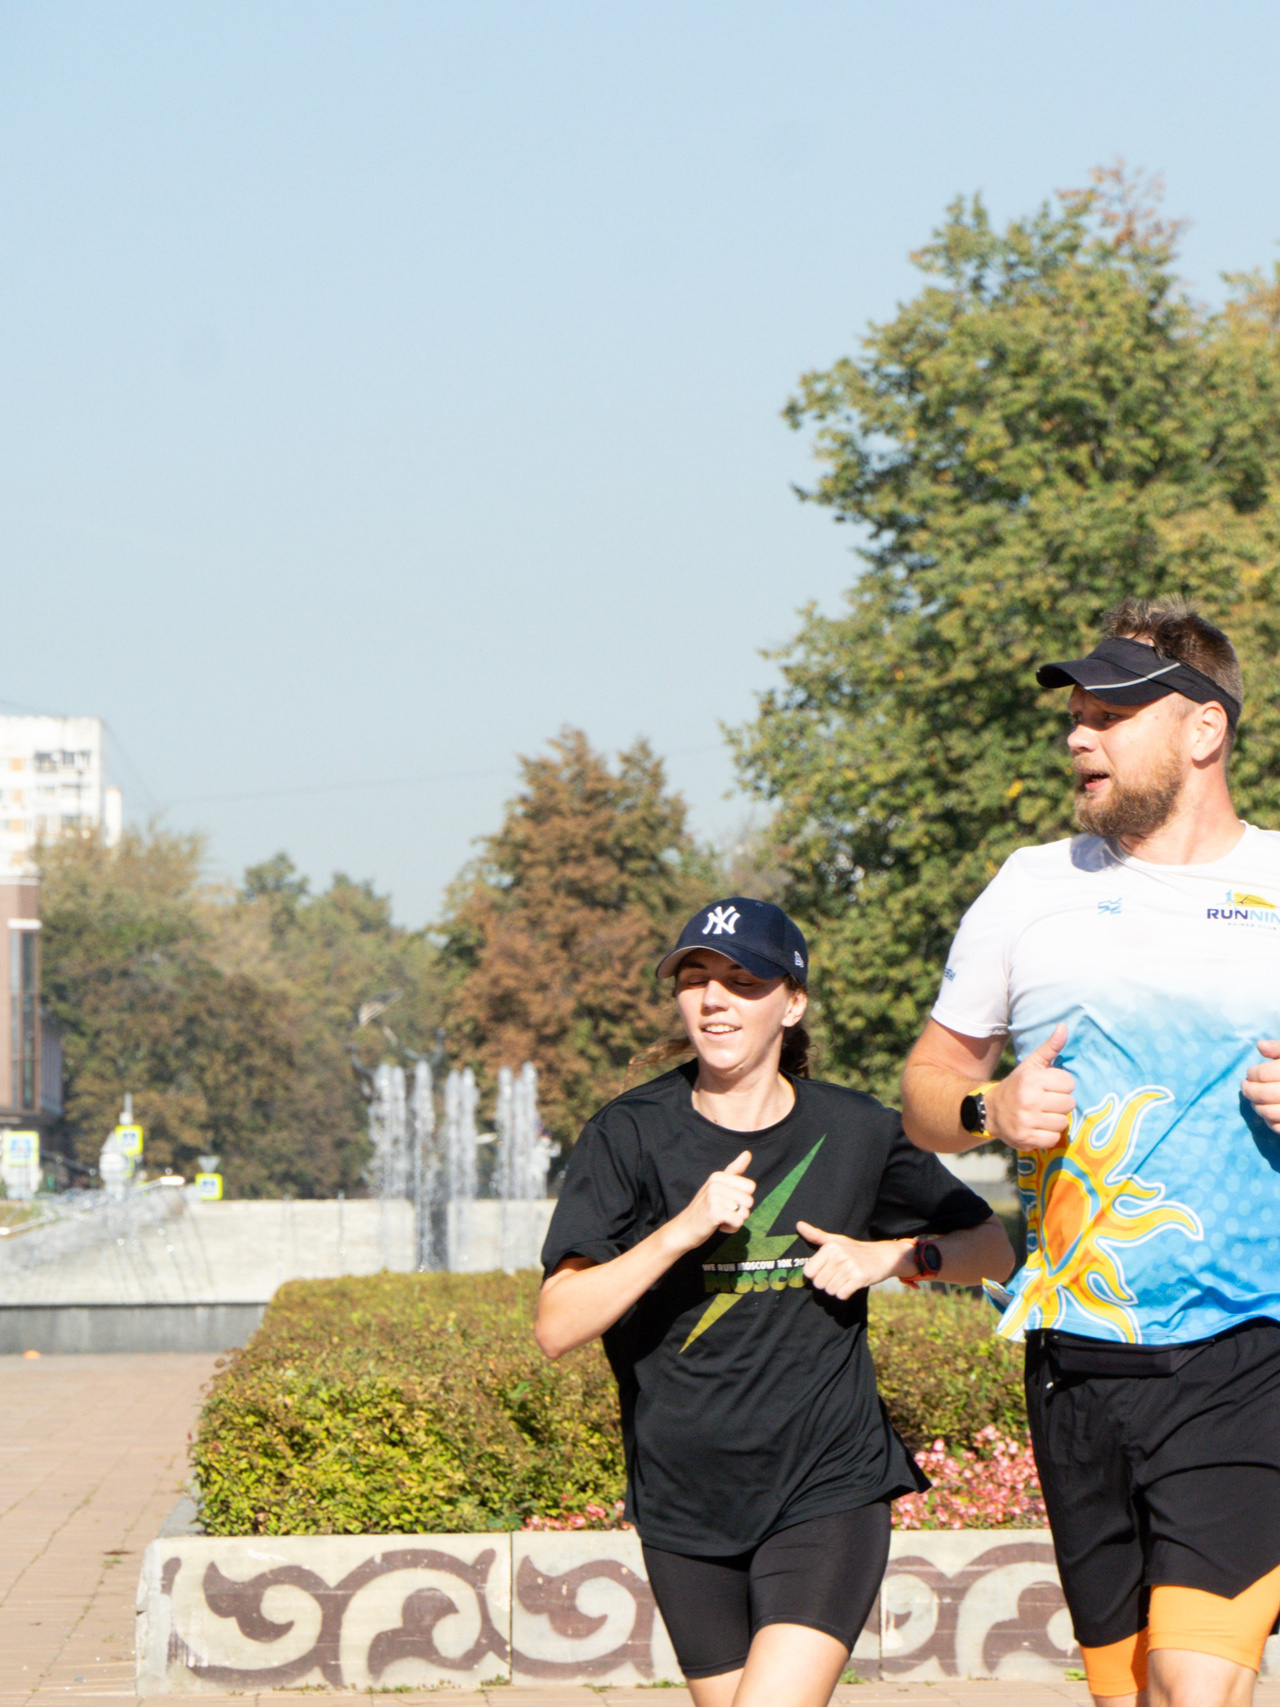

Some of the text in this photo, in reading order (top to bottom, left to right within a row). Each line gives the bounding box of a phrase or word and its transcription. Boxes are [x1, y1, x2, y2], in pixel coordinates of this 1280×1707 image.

[702, 1263, 717, 1272] WE
[717, 1262, 736, 1272] RUN
[737, 1260, 776, 1272] MOSCOW
[777, 1258, 794, 1269] 10K
